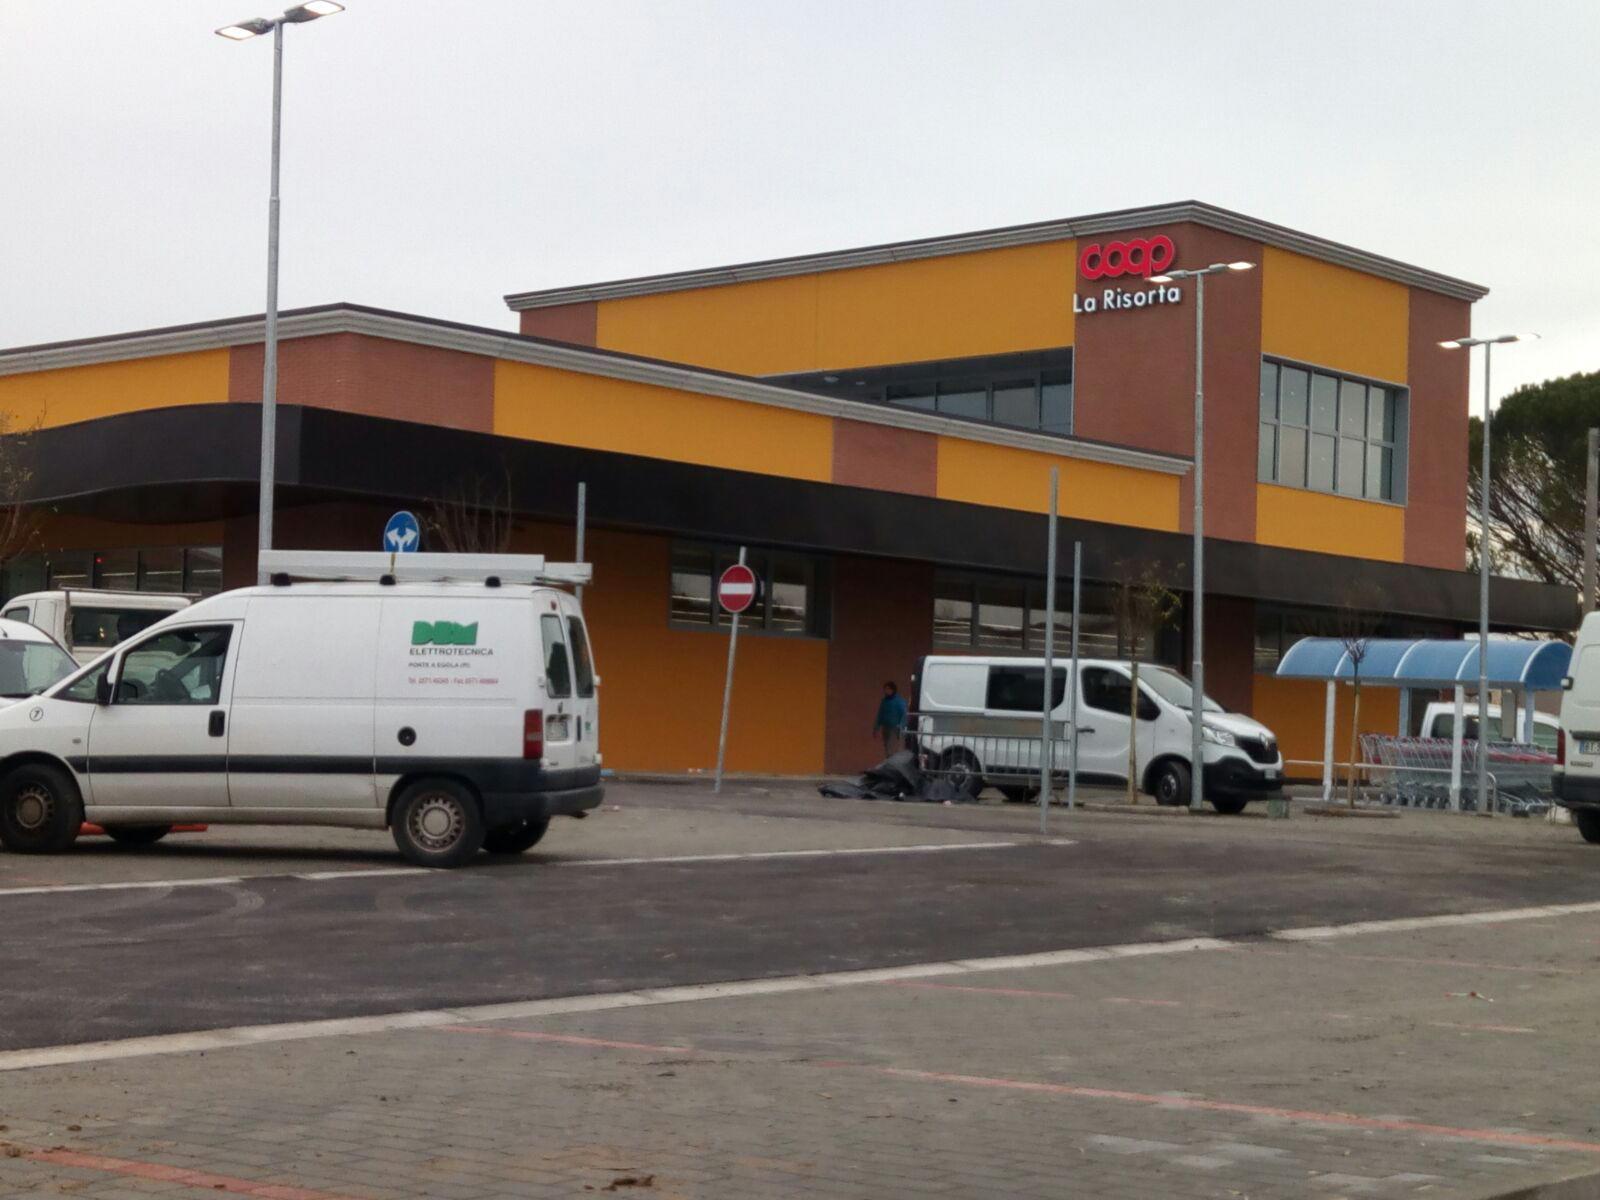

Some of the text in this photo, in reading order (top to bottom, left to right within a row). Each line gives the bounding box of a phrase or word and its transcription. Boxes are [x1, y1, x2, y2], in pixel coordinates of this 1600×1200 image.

[1080, 234, 1175, 281] coop
[1072, 285, 1181, 313] La Risorta
[409, 647, 494, 656] ELETTROTECNICA
